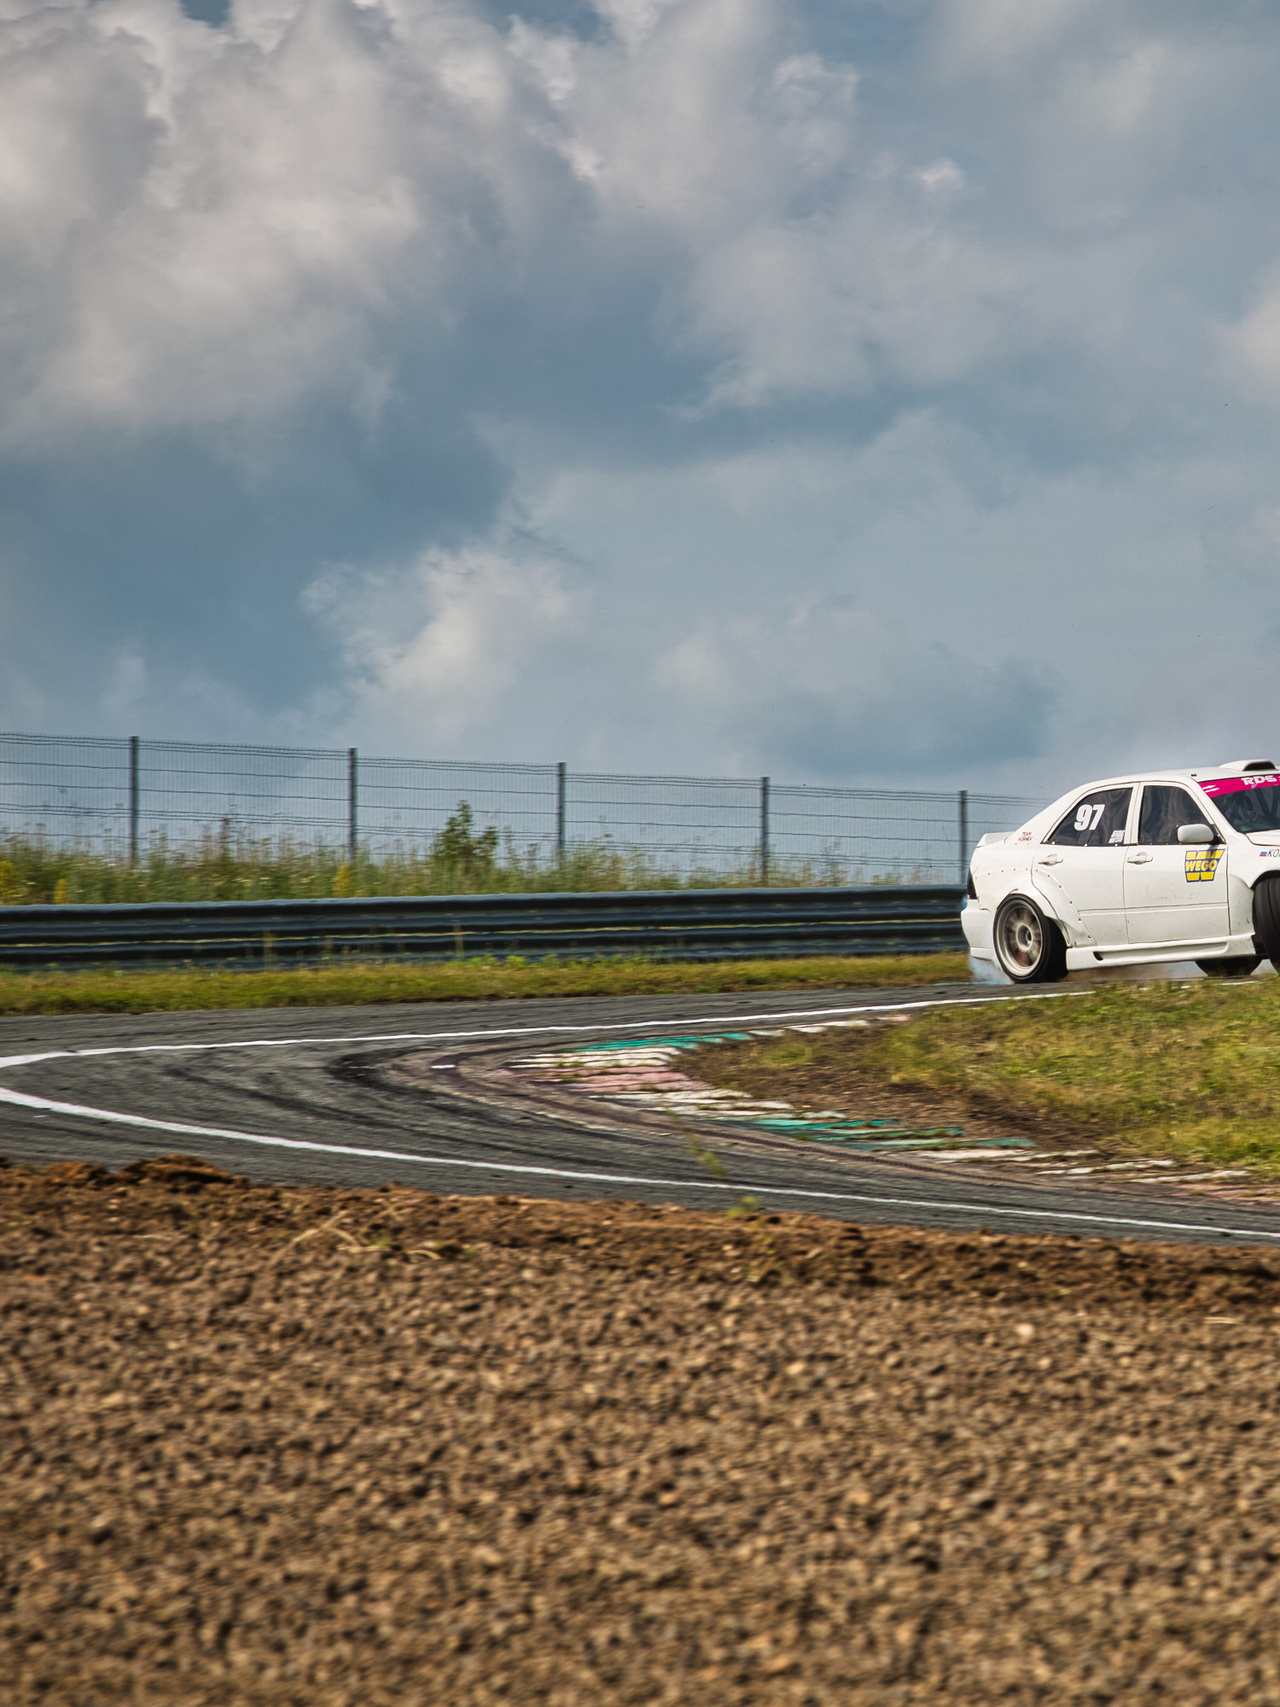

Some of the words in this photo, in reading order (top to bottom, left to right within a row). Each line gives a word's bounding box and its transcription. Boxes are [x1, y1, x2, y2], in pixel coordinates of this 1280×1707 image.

[1241, 775, 1277, 785] RDS
[1073, 804, 1105, 831] 97
[1185, 859, 1218, 872] WEGO
